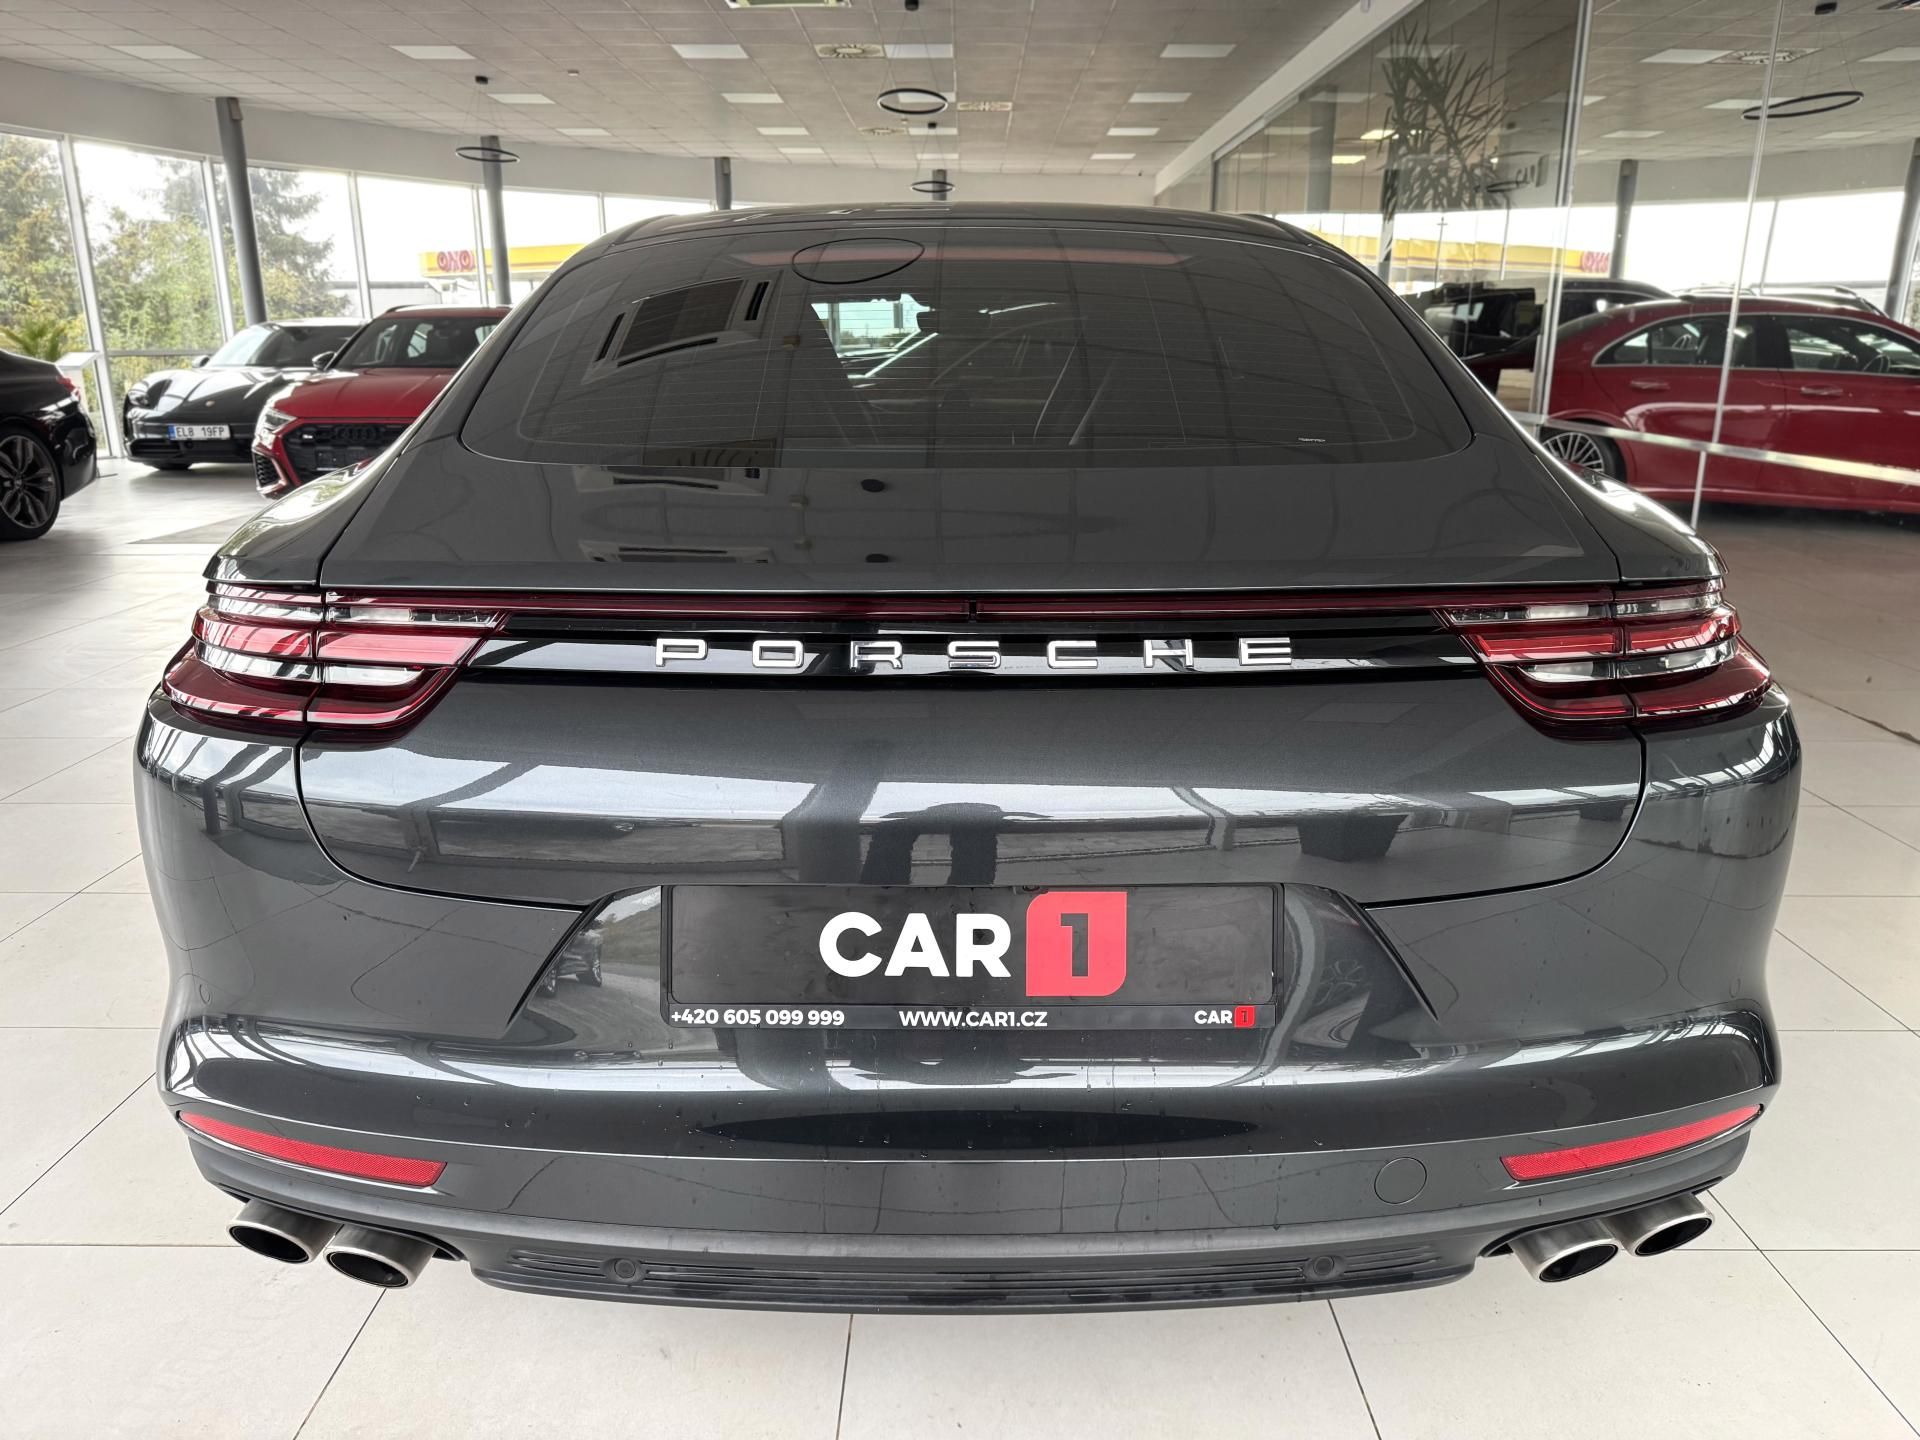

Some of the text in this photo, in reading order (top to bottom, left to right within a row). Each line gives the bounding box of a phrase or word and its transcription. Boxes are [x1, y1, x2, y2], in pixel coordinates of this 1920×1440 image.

[176, 426, 225, 438] EL8 19FP
[655, 637, 1293, 670] PORSCHE
[819, 911, 1012, 978] CAR
[671, 1008, 845, 1026] +420 605 099 999
[899, 1011, 1048, 1027] WWW.CAR1.CZ
[1194, 1009, 1233, 1025] CAR
